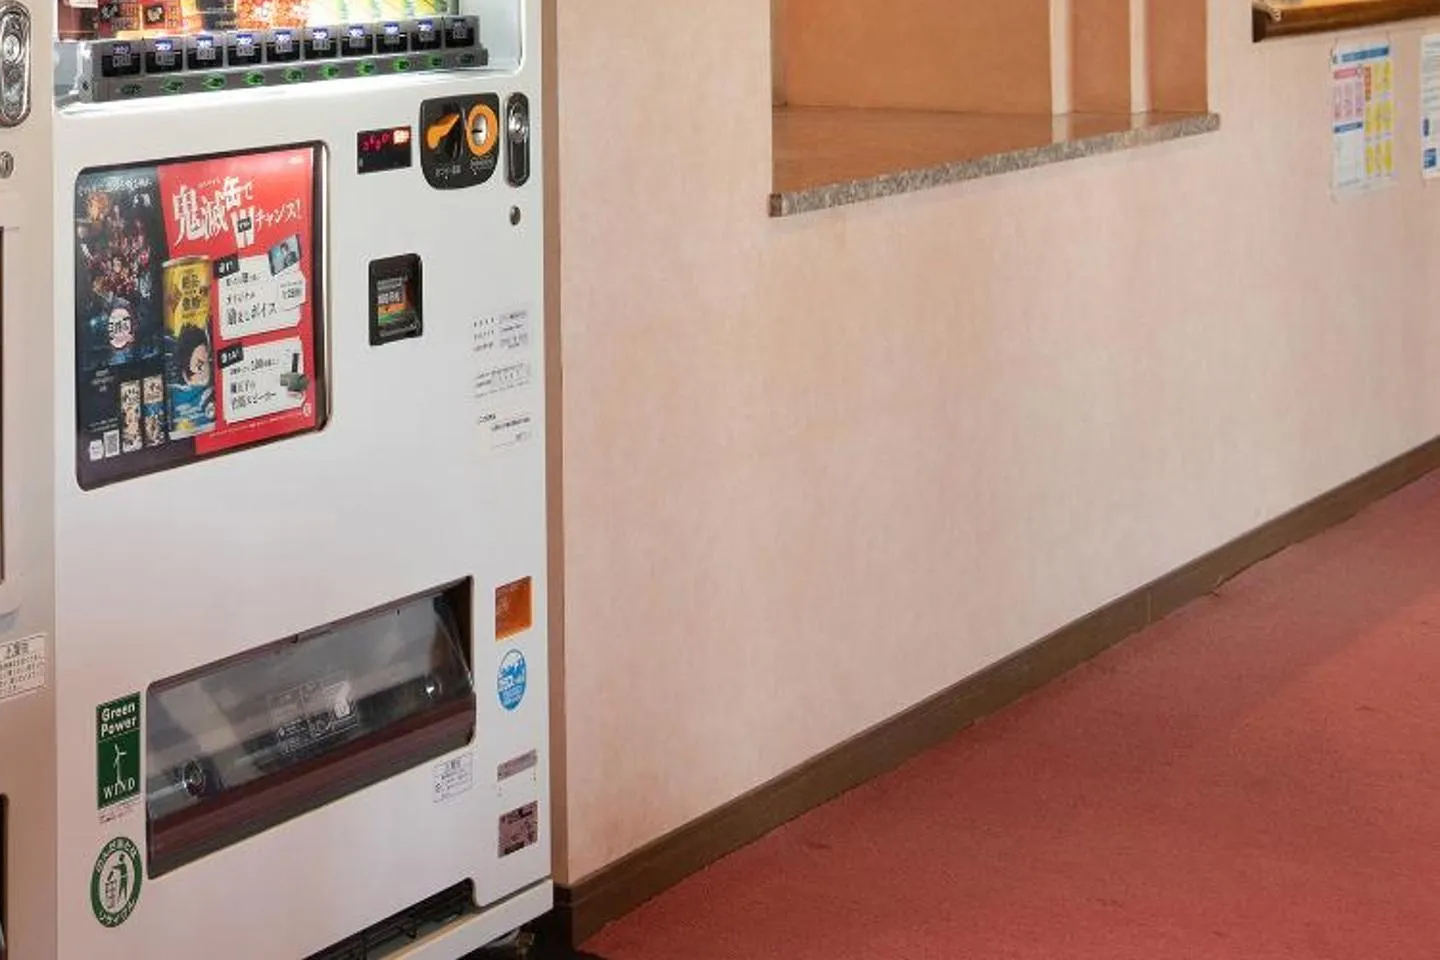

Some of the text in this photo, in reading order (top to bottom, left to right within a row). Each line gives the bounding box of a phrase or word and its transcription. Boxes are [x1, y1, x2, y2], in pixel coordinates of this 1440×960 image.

[102, 703, 135, 722] Green
[101, 717, 137, 737] Power
[103, 777, 136, 800] WIND
